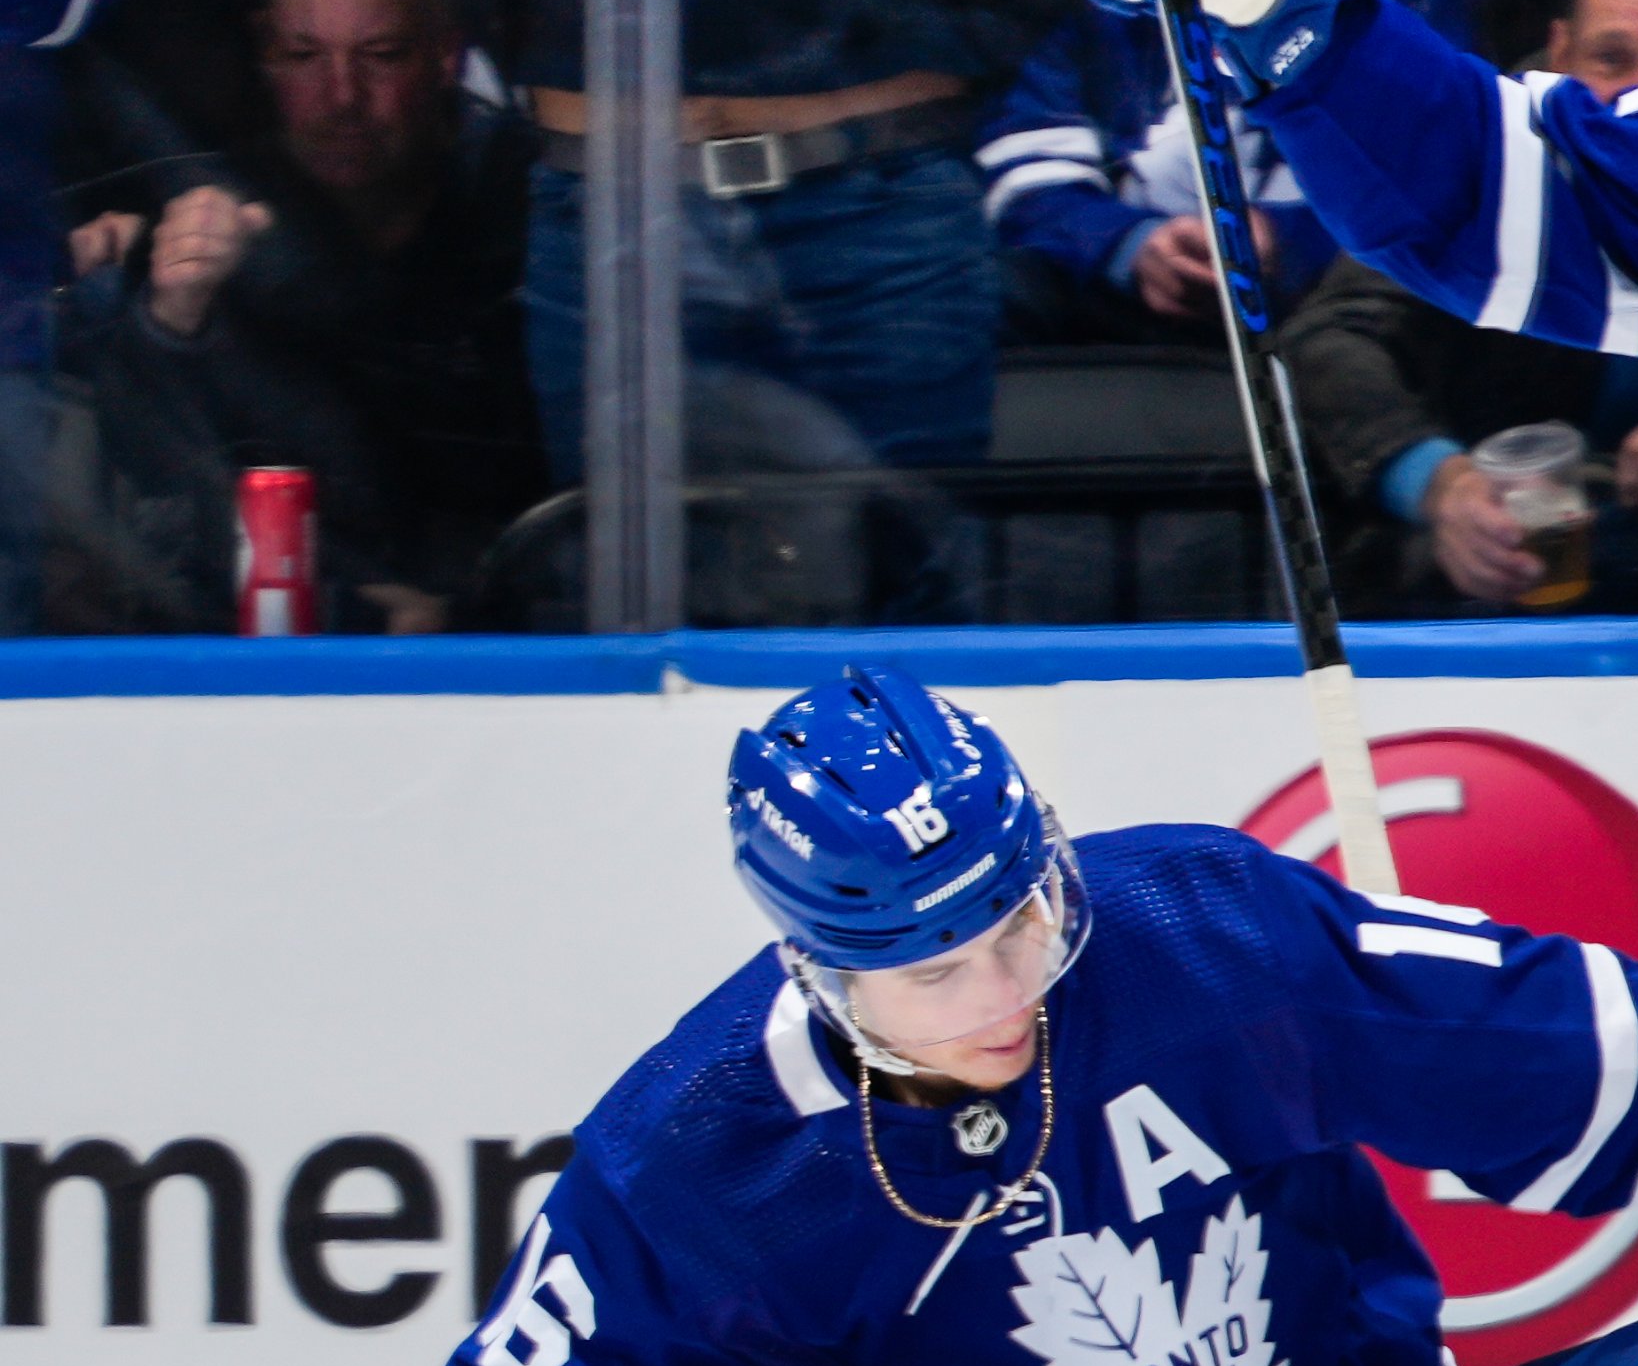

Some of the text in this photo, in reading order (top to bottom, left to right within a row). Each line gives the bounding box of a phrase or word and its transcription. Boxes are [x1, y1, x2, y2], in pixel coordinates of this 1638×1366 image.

[883, 788, 950, 853] 16
[914, 852, 997, 913] WARRIOR
[1105, 1084, 1232, 1223] A
